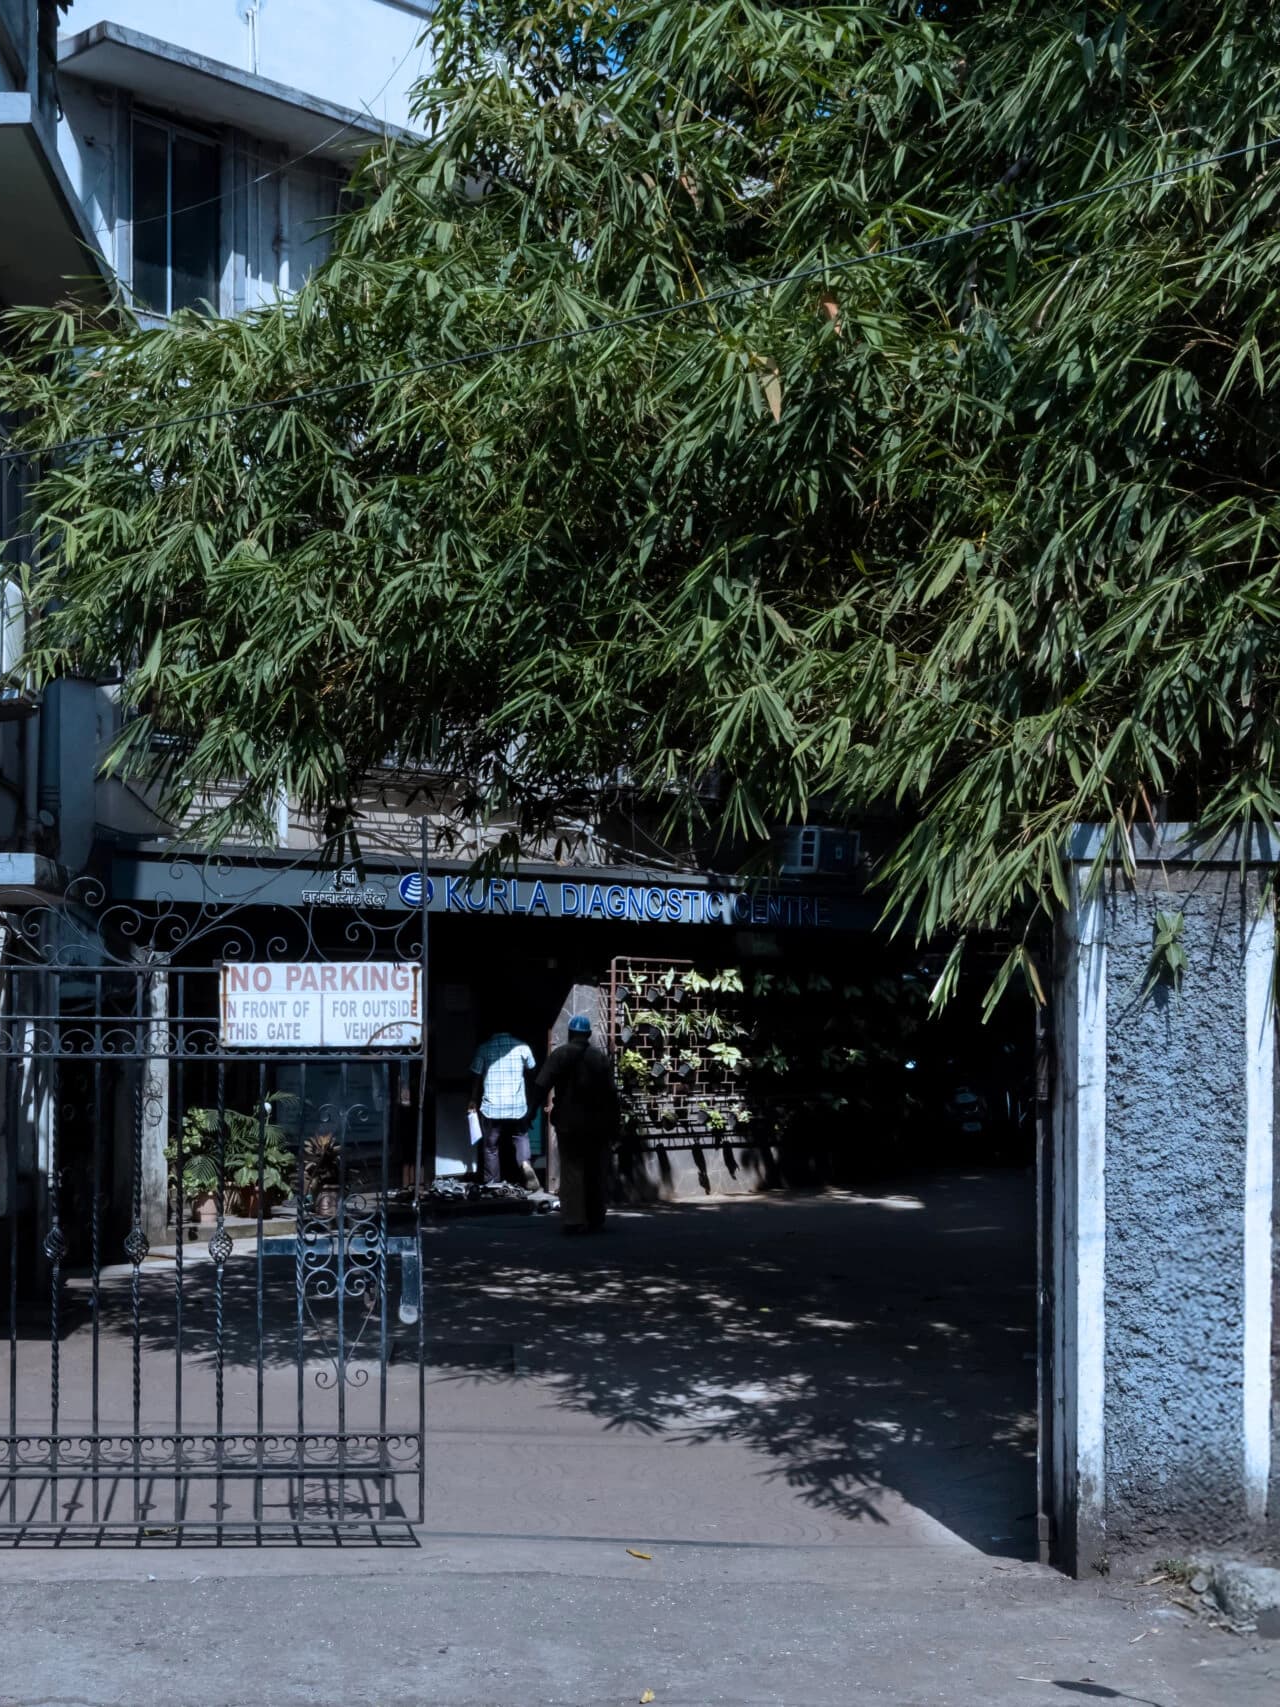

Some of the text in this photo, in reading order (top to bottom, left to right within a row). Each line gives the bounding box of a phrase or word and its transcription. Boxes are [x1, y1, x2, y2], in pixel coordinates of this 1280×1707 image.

[445, 875, 833, 926] KURLA DIAGNOSTIC CENTRE
[230, 965, 410, 992] NO PARKING
[242, 1000, 287, 1018] FRONT
[293, 1000, 310, 1018] OF
[332, 999, 418, 1018] FOR OUTSIDE
[227, 1022, 302, 1040] THIS GATE
[343, 1022, 404, 1040] VEHICLES
